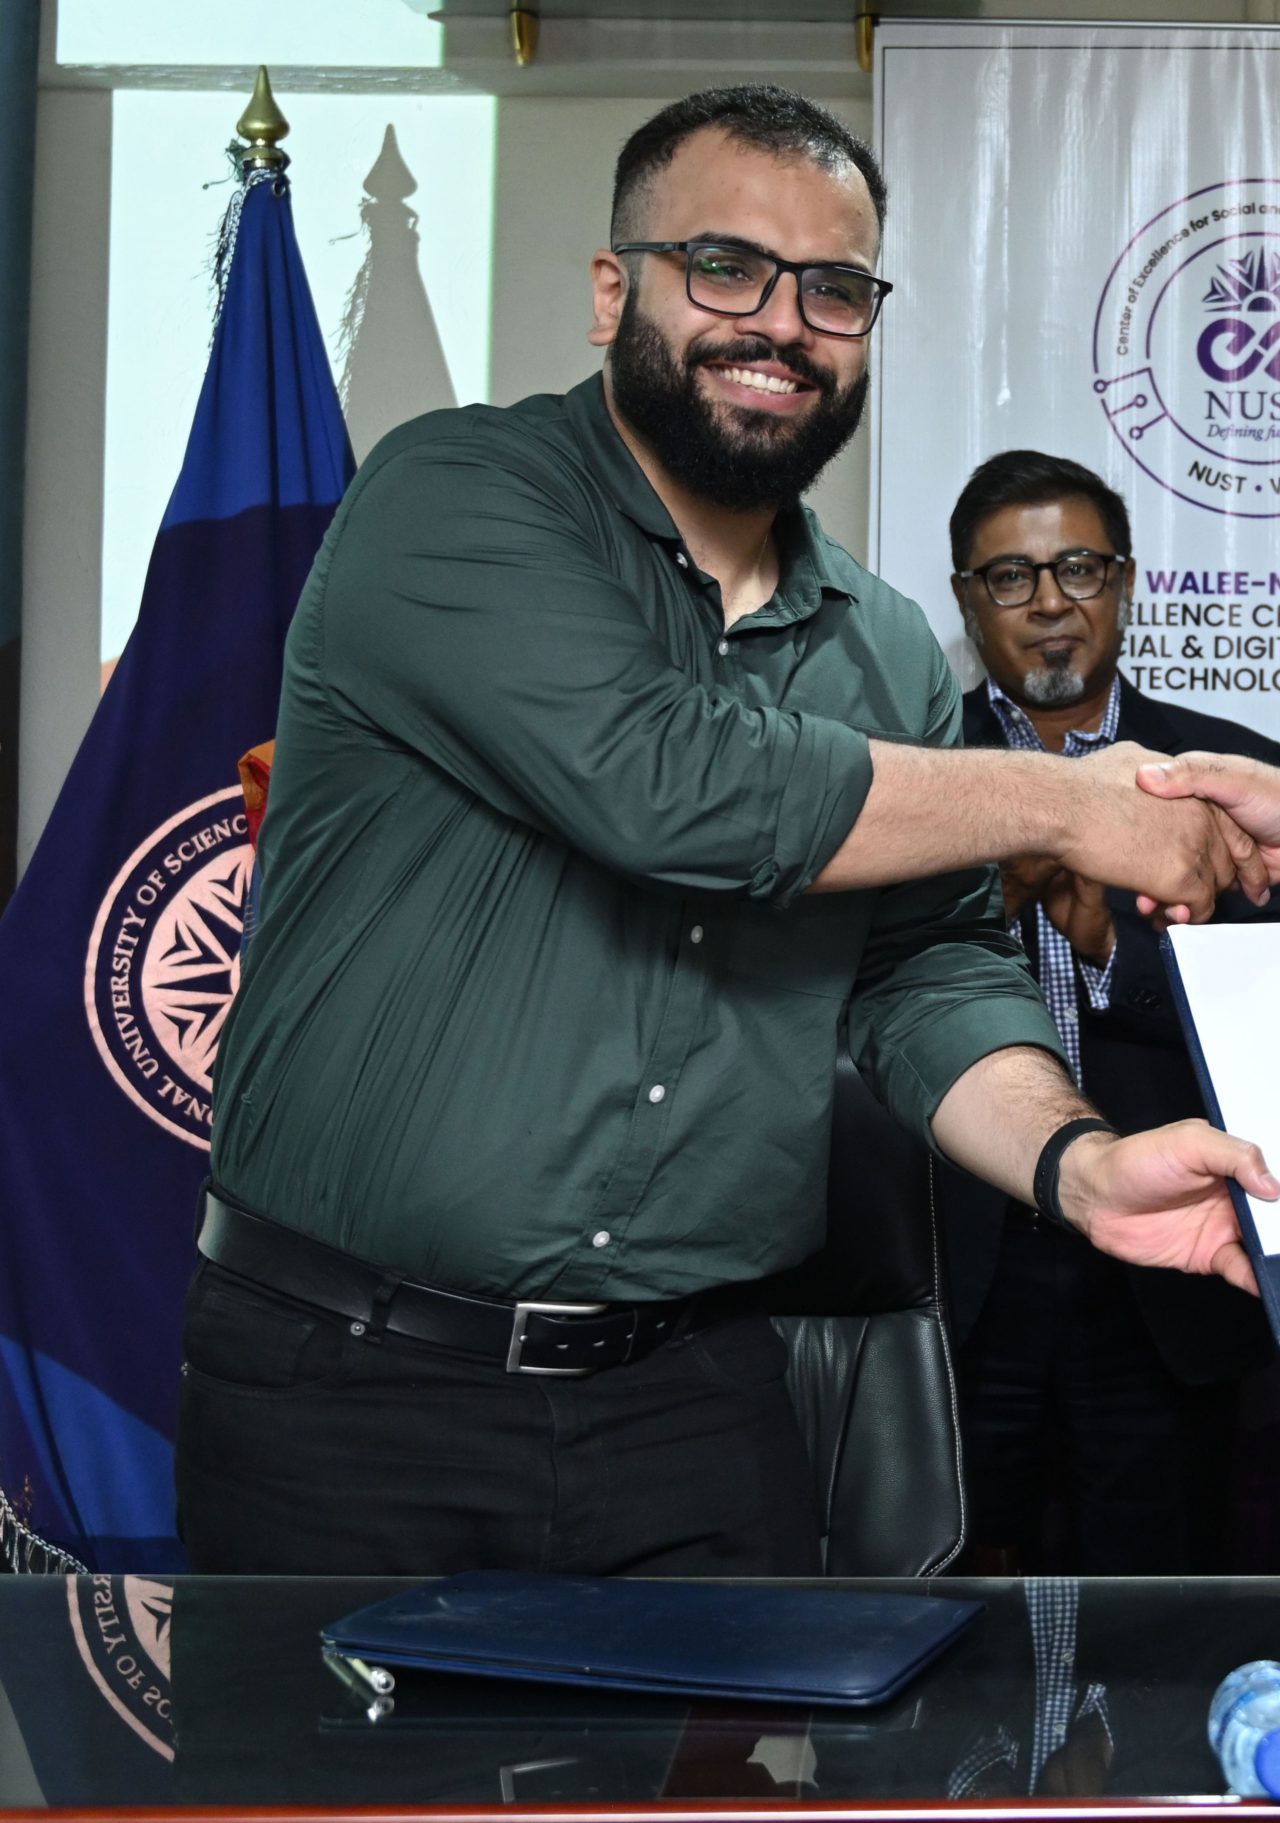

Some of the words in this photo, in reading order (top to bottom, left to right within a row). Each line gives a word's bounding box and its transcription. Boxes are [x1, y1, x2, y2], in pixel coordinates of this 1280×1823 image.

[1189, 214, 1210, 233] for
[1211, 202, 1256, 222] Social
[1132, 227, 1191, 289] Excellence
[1128, 284, 1140, 304] of
[1117, 306, 1133, 356] Center
[1207, 424, 1263, 442] Defining
[1188, 460, 1248, 494] NUST
[1181, 634, 1204, 660] &
[111, 905, 160, 1080] UNIVERSITY
[136, 869, 169, 907] OF
[163, 813, 249, 876] SCIENC
